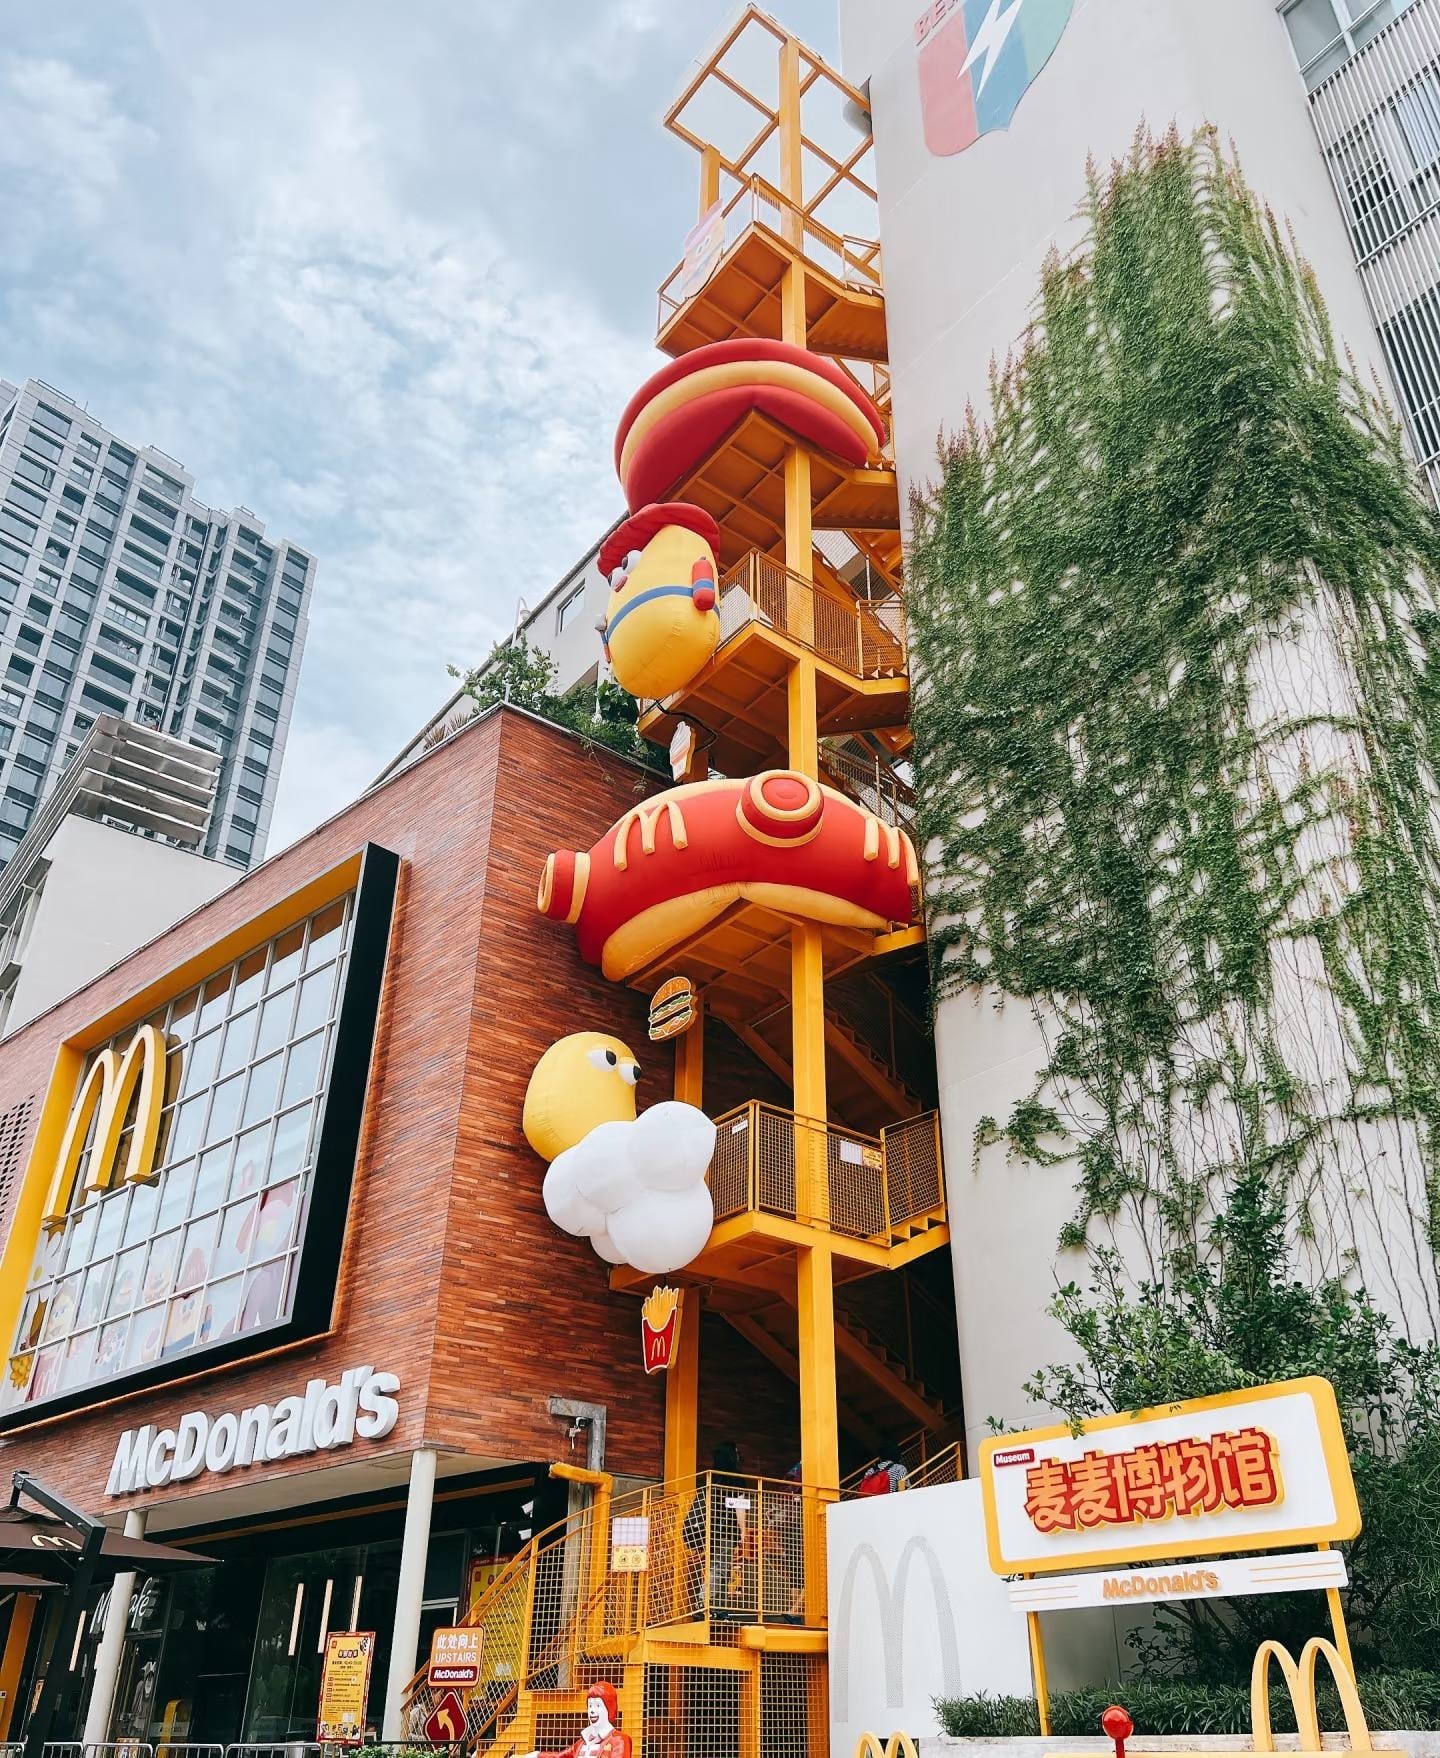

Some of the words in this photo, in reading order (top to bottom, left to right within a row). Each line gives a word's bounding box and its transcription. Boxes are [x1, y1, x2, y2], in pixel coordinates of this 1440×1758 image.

[103, 1365, 401, 1496] McDonald's
[996, 1452, 1031, 1464] Museum
[1025, 1427, 1278, 1533] 麦麦博物馆
[1102, 1569, 1219, 1599] McDonald's
[436, 1633, 479, 1649] 此处向上
[435, 1651, 477, 1664] UPSTAIRS
[433, 1668, 474, 1679] McDonald's
